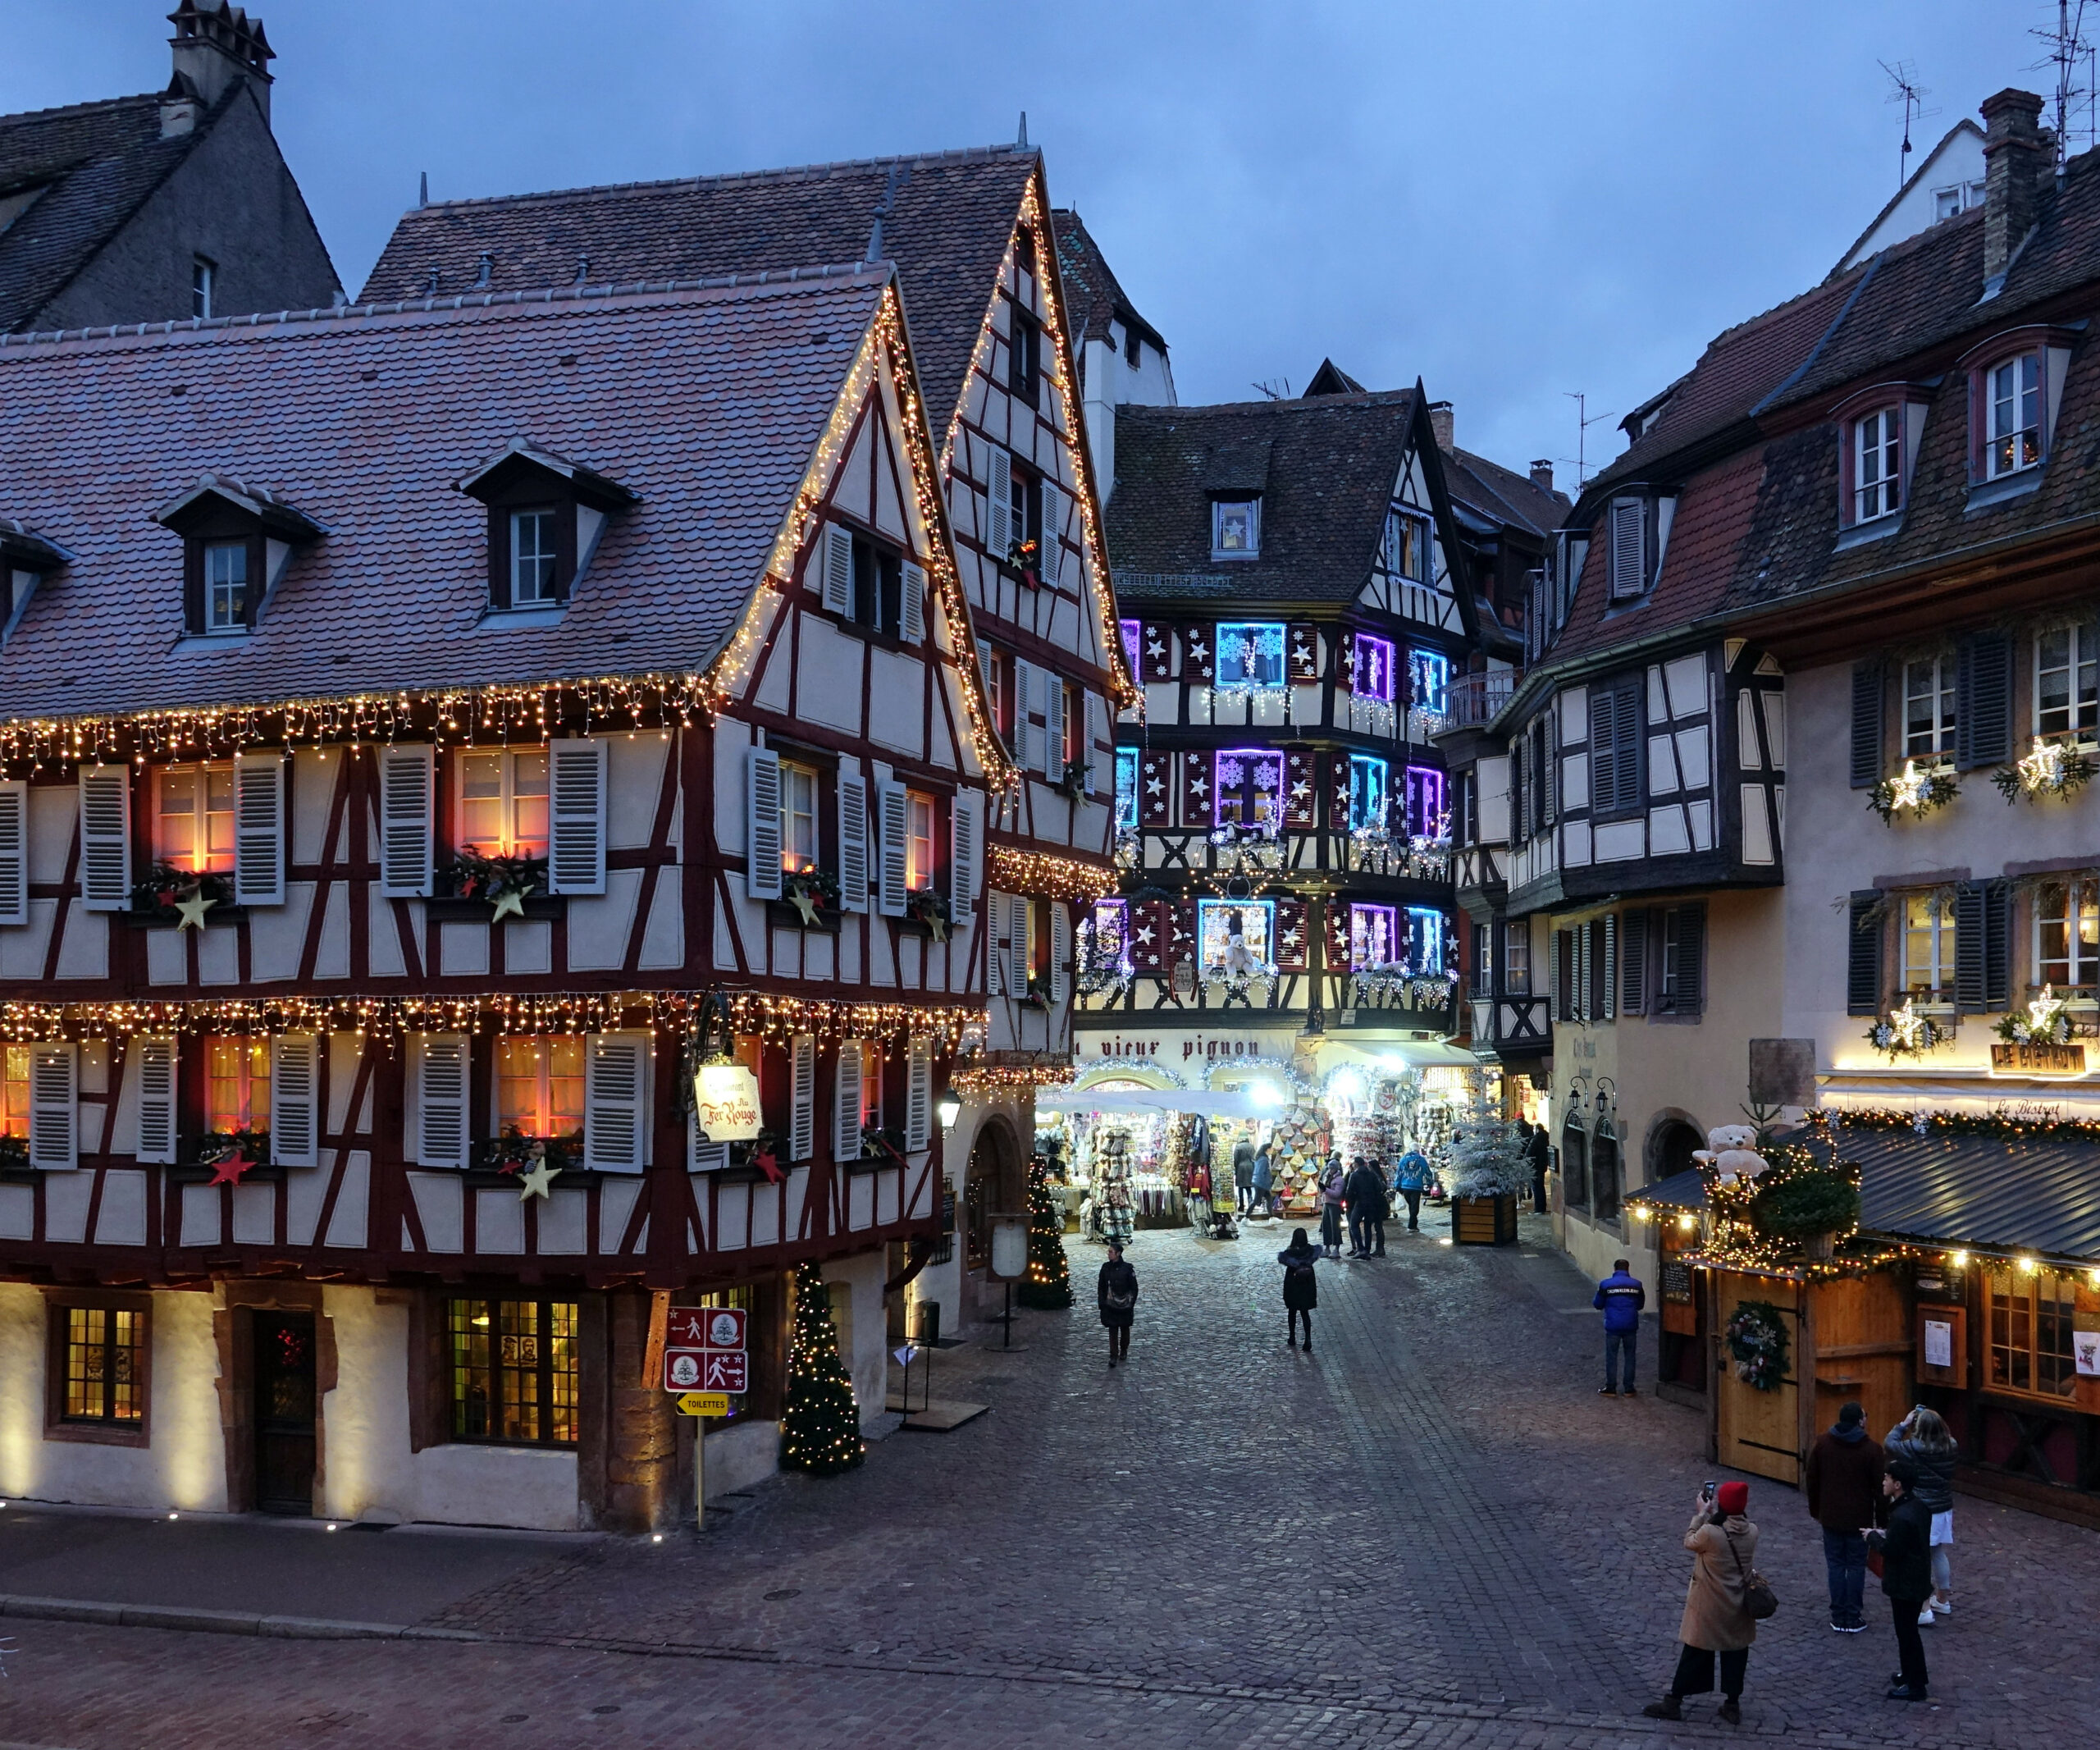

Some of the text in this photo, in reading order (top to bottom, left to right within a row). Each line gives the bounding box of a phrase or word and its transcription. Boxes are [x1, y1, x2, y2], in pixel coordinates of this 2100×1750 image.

[1182, 1034, 1259, 1062] pignon
[701, 1100, 757, 1126] Fer Rouge
[1998, 1099, 2060, 1115] Le Bistrot
[687, 1400, 725, 1409] TOILETTES
